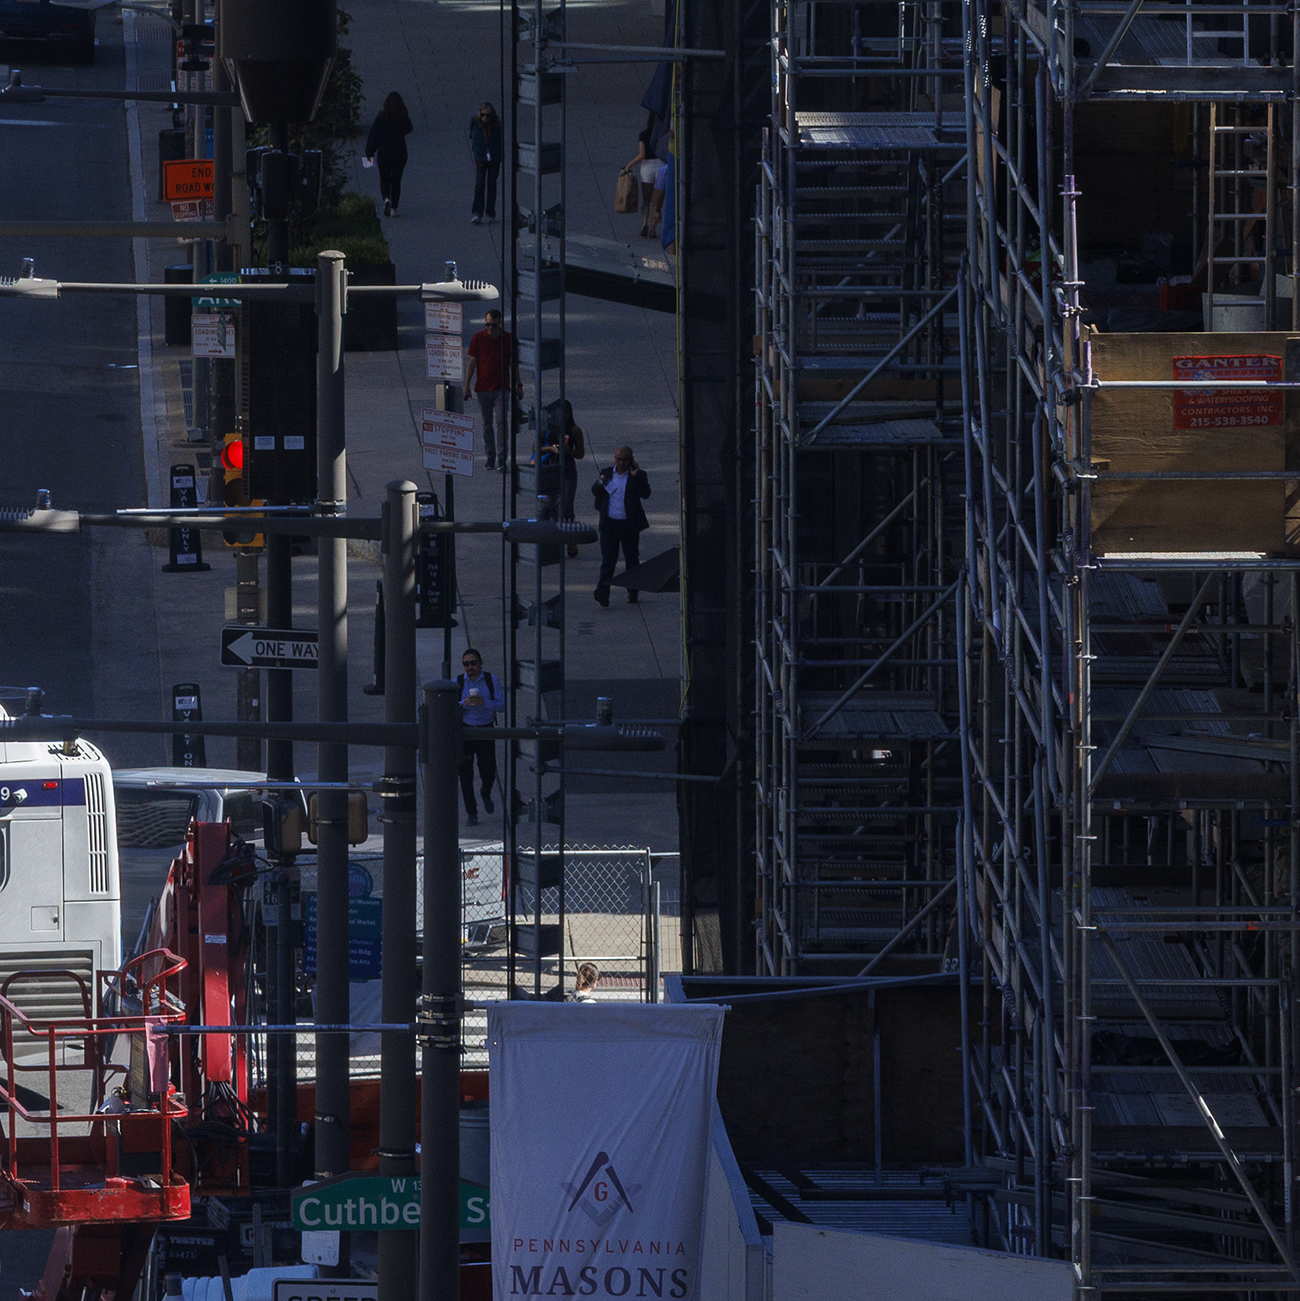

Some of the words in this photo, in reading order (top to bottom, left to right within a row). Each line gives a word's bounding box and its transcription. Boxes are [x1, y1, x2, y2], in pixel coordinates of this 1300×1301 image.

[191, 167, 212, 178] END
[175, 183, 201, 194] ROAD
[179, 203, 190, 211] NO
[220, 277, 237, 285] 1400
[428, 349, 447, 357] LOADING
[1176, 358, 1281, 369] GANTER
[1196, 395, 1270, 404] WATERPROOFING
[1181, 406, 1254, 416] CONTRACTORS,
[1190, 415, 1269, 427] 215-538-3540
[423, 423, 434, 431] NO
[434, 424, 466, 437] STOPPING
[425, 446, 439, 454] VALET
[440, 448, 459, 459] PARKING
[460, 451, 472, 462] ONLY
[255, 642, 286, 656] ONE
[265, 883, 272, 893] 4
[265, 893, 277, 904] 16
[390, 1178, 406, 1193] W
[593, 1181, 608, 1202] G
[299, 1197, 421, 1227] Cuthbe
[169, 1237, 215, 1246] TUBSTER
[513, 1238, 687, 1256] PENNSYLVANIA
[509, 1265, 689, 1299] MASONS
